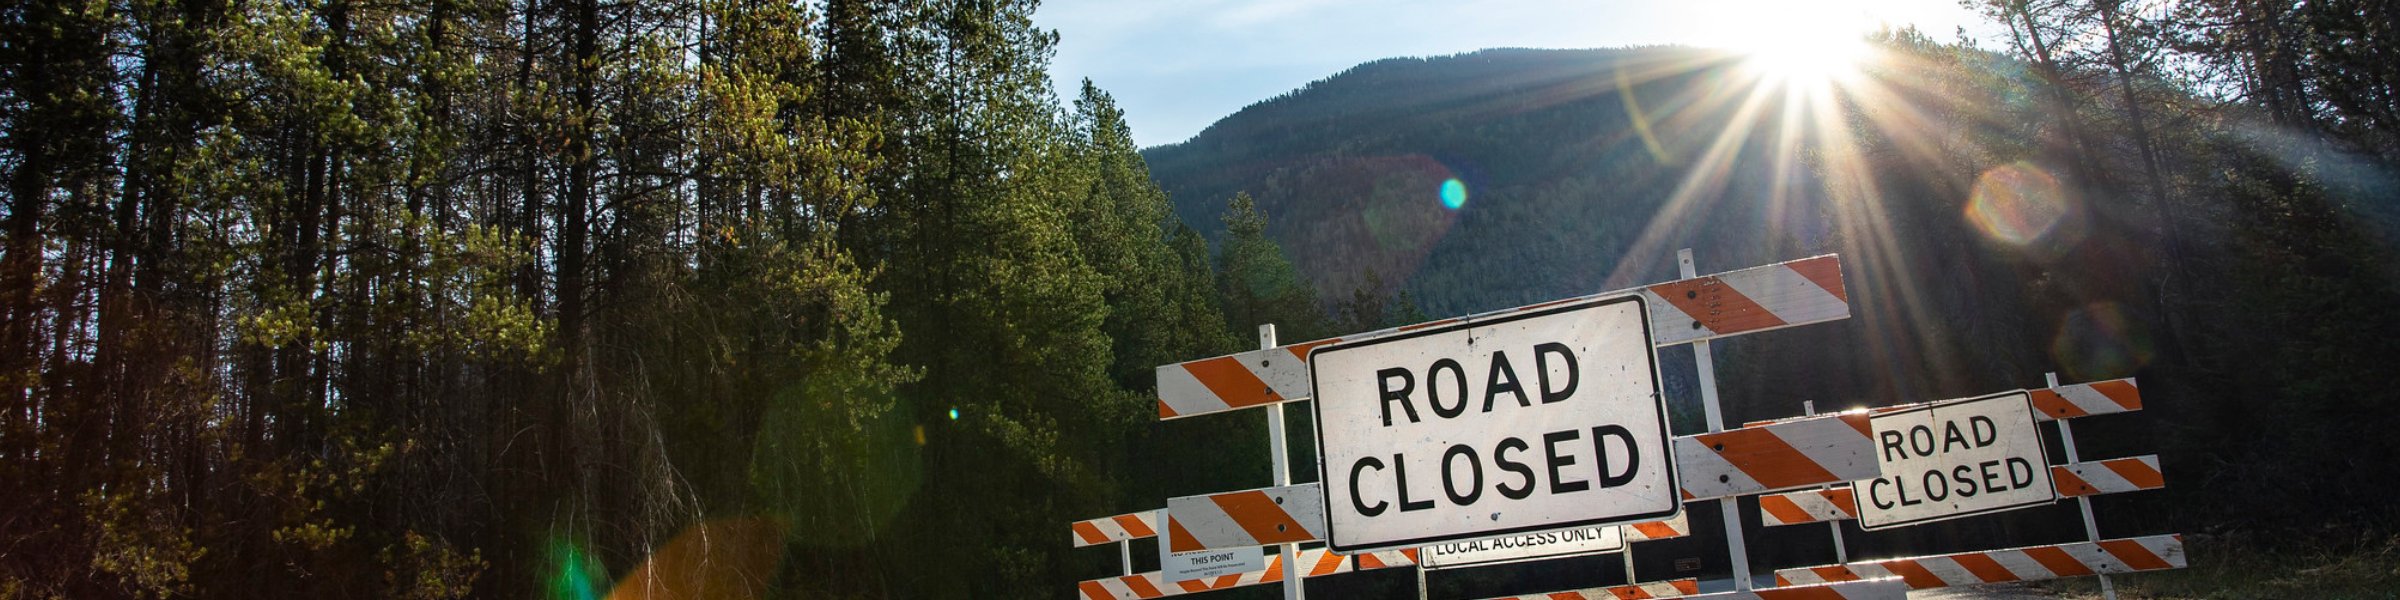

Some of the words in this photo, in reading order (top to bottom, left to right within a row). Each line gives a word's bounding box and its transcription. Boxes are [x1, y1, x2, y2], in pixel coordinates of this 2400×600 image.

[1377, 342, 1580, 427] ROAD
[1880, 415, 1997, 462] ROAD
[1349, 424, 1640, 517] CLOSED
[1870, 457, 2034, 510] CLOSED
[1190, 556, 1209, 566] THIS
[1210, 552, 1235, 563] POINT
[1435, 541, 1489, 556] LOCAL
[1492, 532, 1558, 550] ACCESS
[1561, 527, 1604, 543] ONLY
